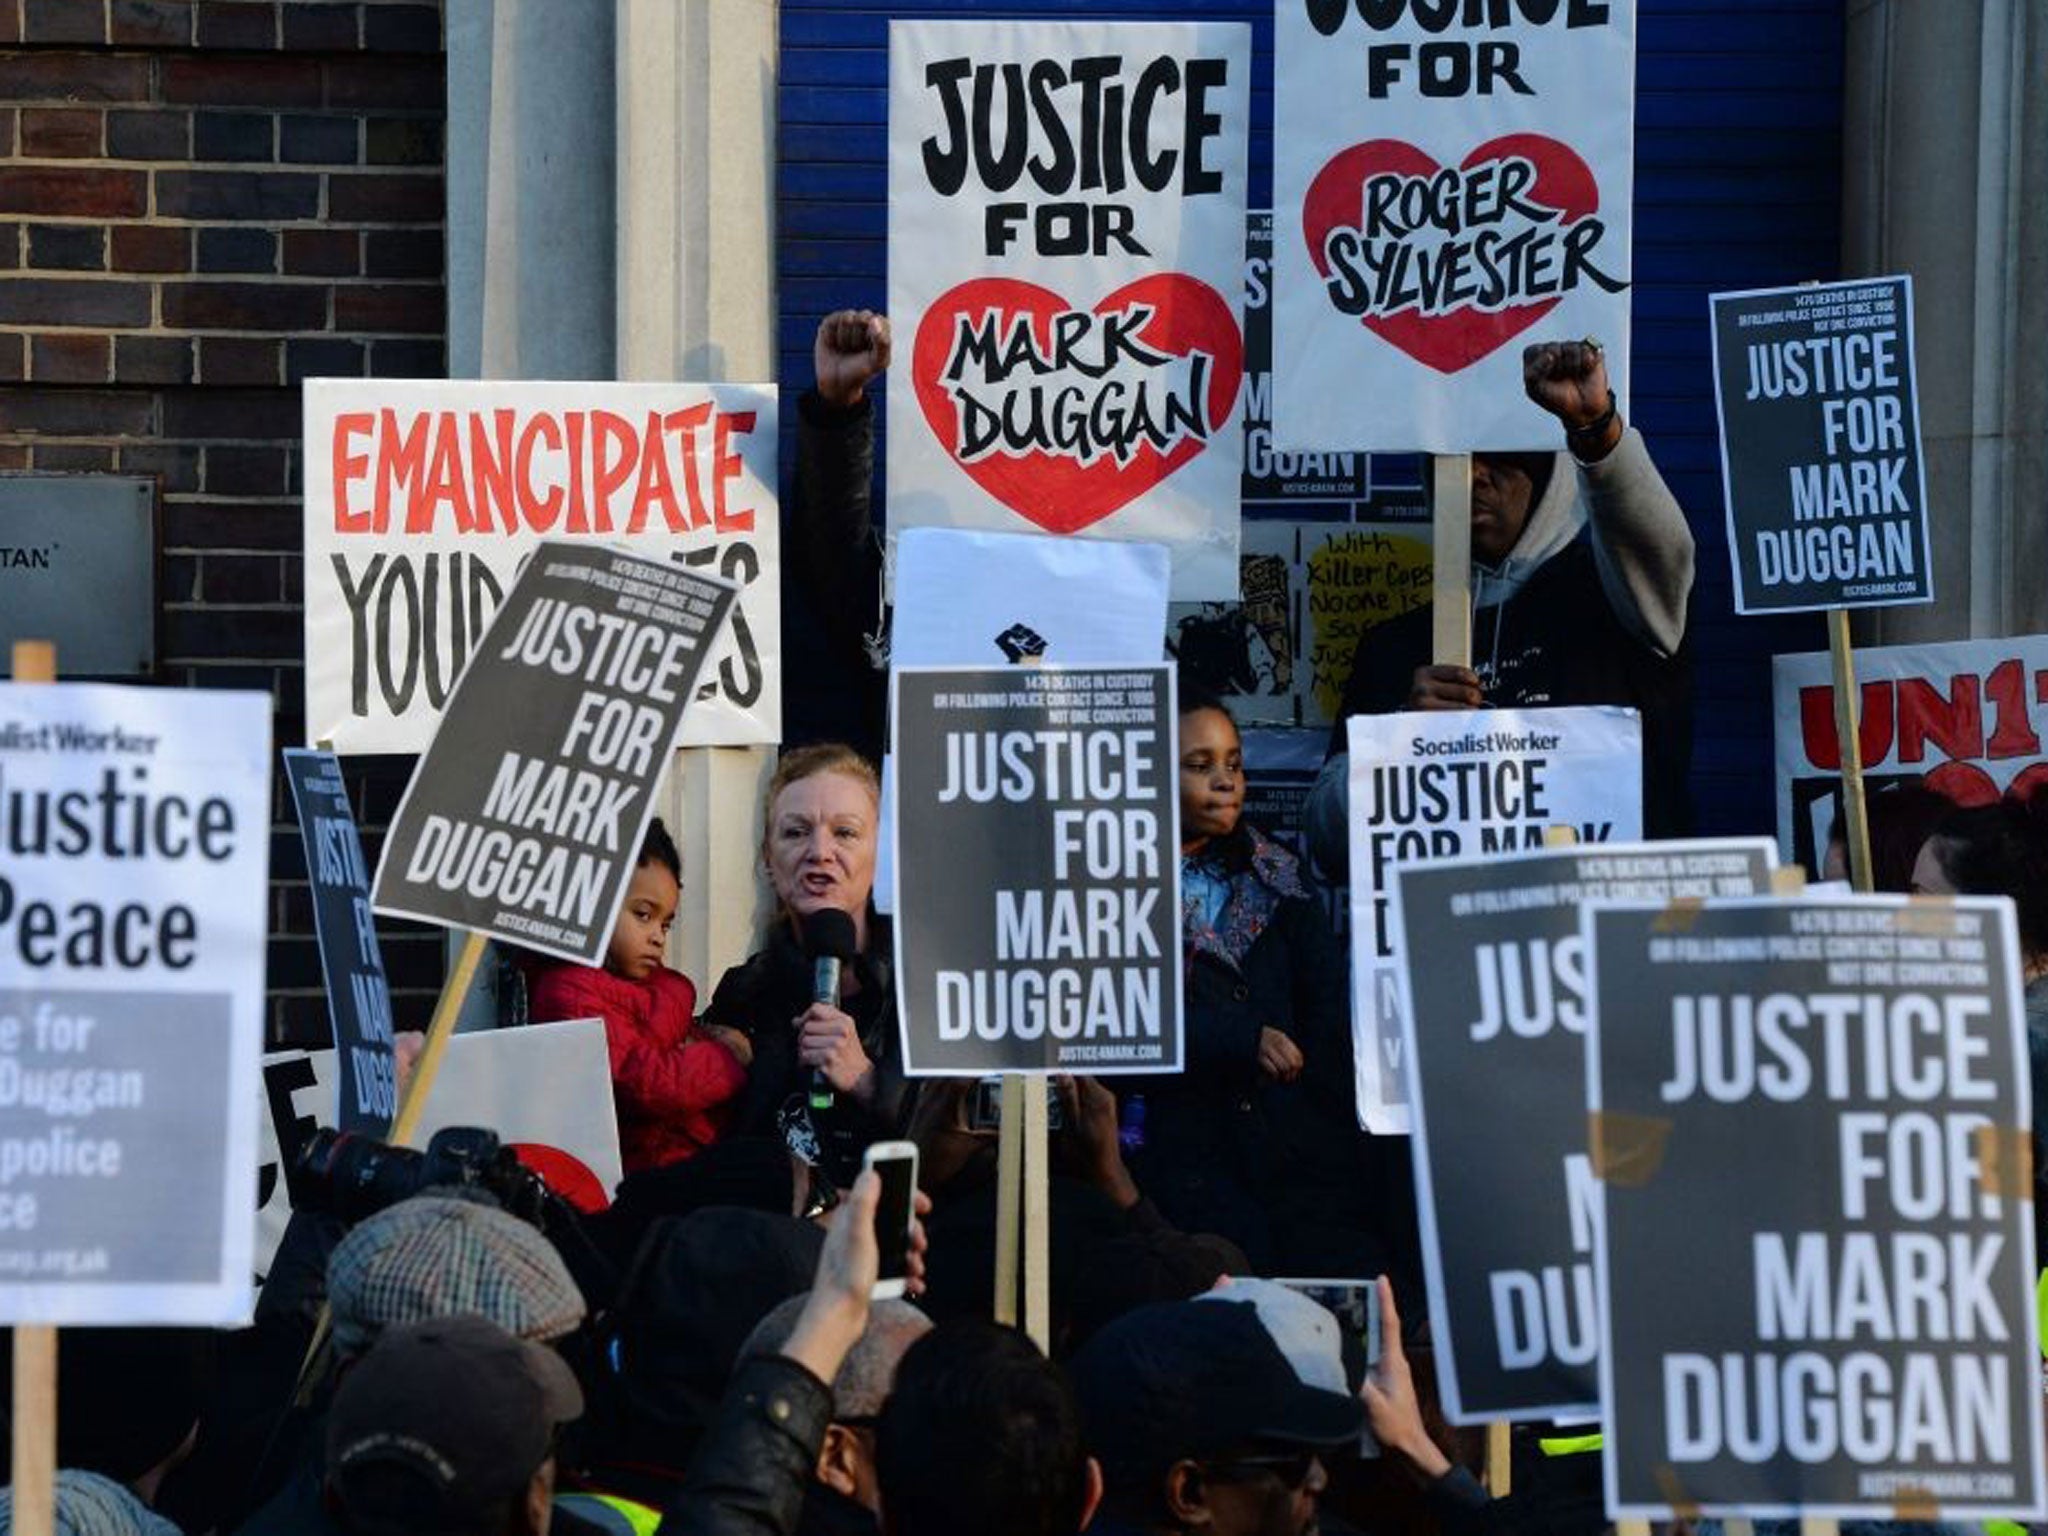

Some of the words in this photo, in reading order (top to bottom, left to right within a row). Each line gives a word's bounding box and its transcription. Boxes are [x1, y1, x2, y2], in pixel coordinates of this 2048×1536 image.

[1368, 41, 1535, 99] FOR
[921, 55, 1228, 196] JUSTICE
[985, 203, 1152, 257] FOR
[1366, 160, 1558, 240] ROGER
[1329, 219, 1631, 315] SYLVESTER
[947, 308, 1172, 383] MARK
[1746, 331, 1899, 400] JUSTICE
[956, 354, 1210, 460] DUGGAN
[1823, 395, 1905, 455] FOR
[333, 401, 756, 536] EMANCIPATE
[1789, 457, 1910, 521] MARK
[1756, 520, 1914, 585] DUGGAN
[500, 597, 697, 704] JUSTICE
[560, 691, 665, 778] FOR
[938, 731, 1157, 802] JUSTICE
[0, 765, 234, 862] ustice
[482, 751, 638, 852] MARK
[1368, 759, 1549, 827] JUSTICE
[405, 815, 610, 927] DUGGAN
[1053, 809, 1159, 880] FOR
[996, 888, 1161, 960] MARK
[35, 1002, 94, 1052] for
[935, 968, 1161, 1041] DUGGAN
[1660, 992, 1998, 1101] JUSTICE
[3, 1127, 120, 1183] police
[1840, 1111, 2003, 1220] FOR
[1753, 1232, 2009, 1341] MARK
[1662, 1352, 2013, 1464] DUGGAN
